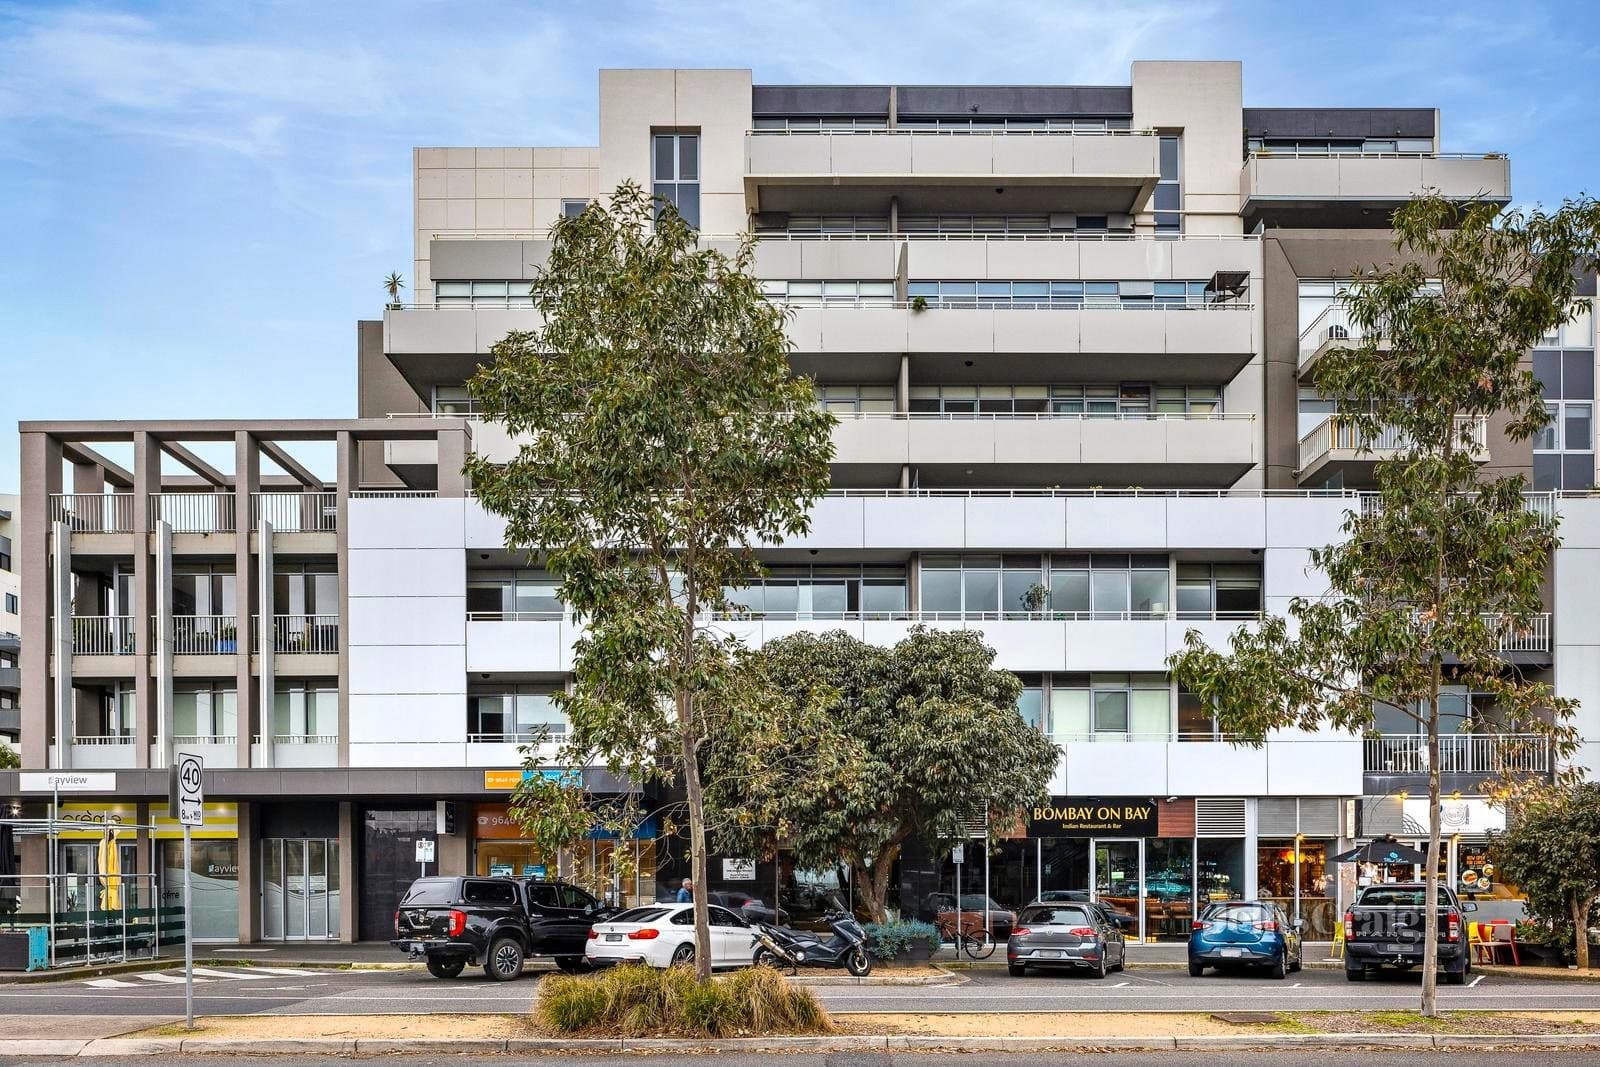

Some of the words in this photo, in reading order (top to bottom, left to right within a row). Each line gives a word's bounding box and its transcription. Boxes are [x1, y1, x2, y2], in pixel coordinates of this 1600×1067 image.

[183, 767, 200, 786] 40
[491, 815, 516, 826] 9646
[1033, 807, 1094, 821] BOMBAY
[1097, 807, 1121, 821] ON
[1125, 807, 1151, 821] BAY
